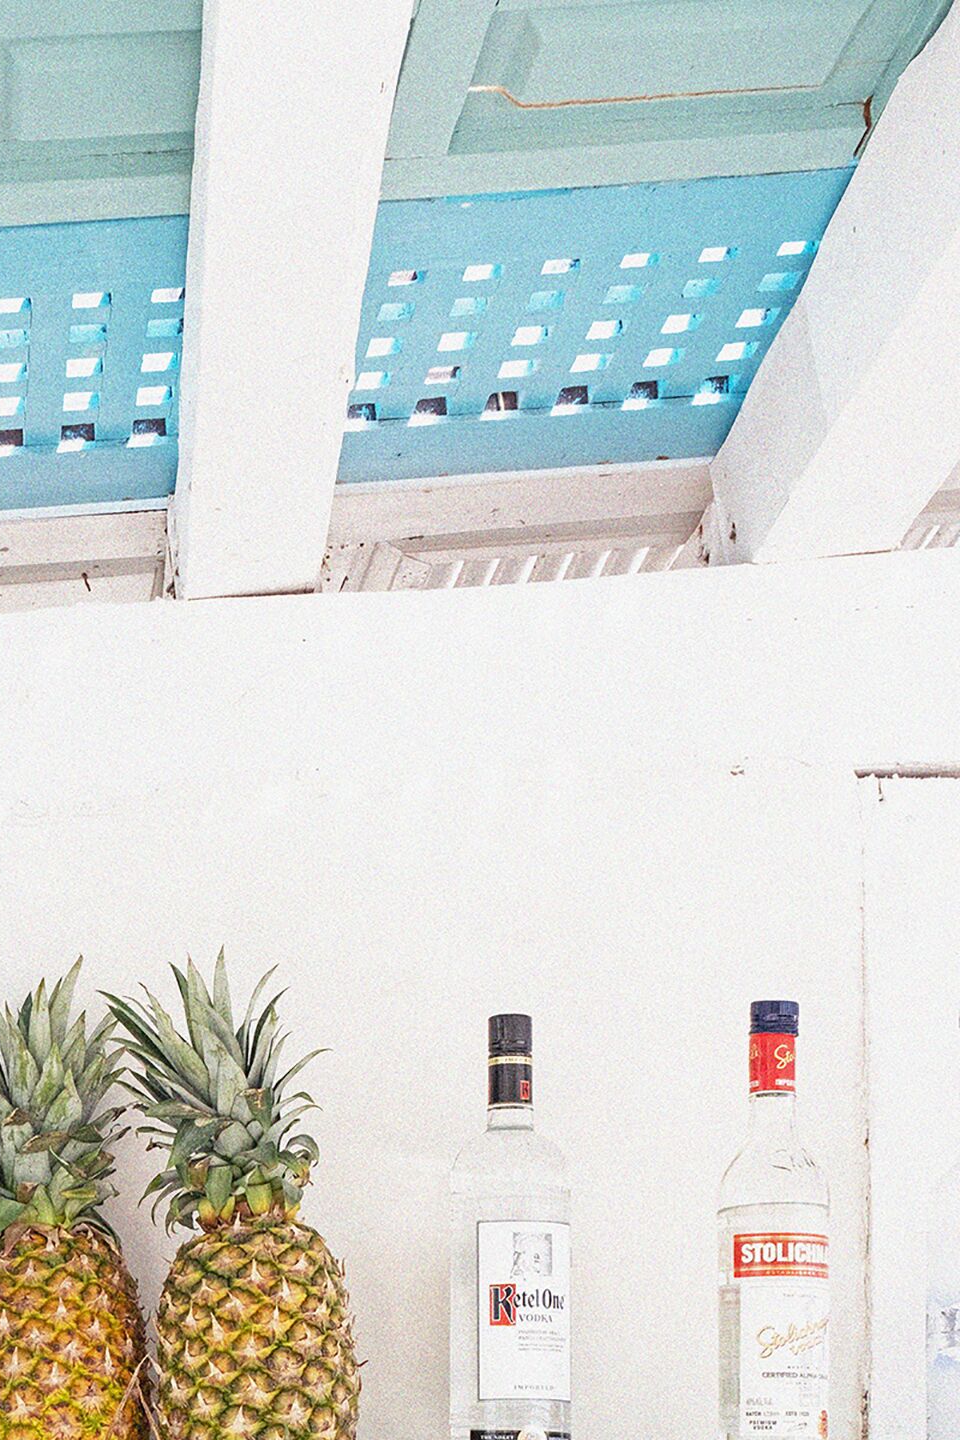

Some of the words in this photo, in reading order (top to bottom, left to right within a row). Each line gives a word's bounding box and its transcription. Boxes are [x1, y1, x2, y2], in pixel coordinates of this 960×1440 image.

[492, 1285, 540, 1324] Ketel
[542, 1288, 565, 1310] One
[519, 1313, 553, 1324] VODKA
